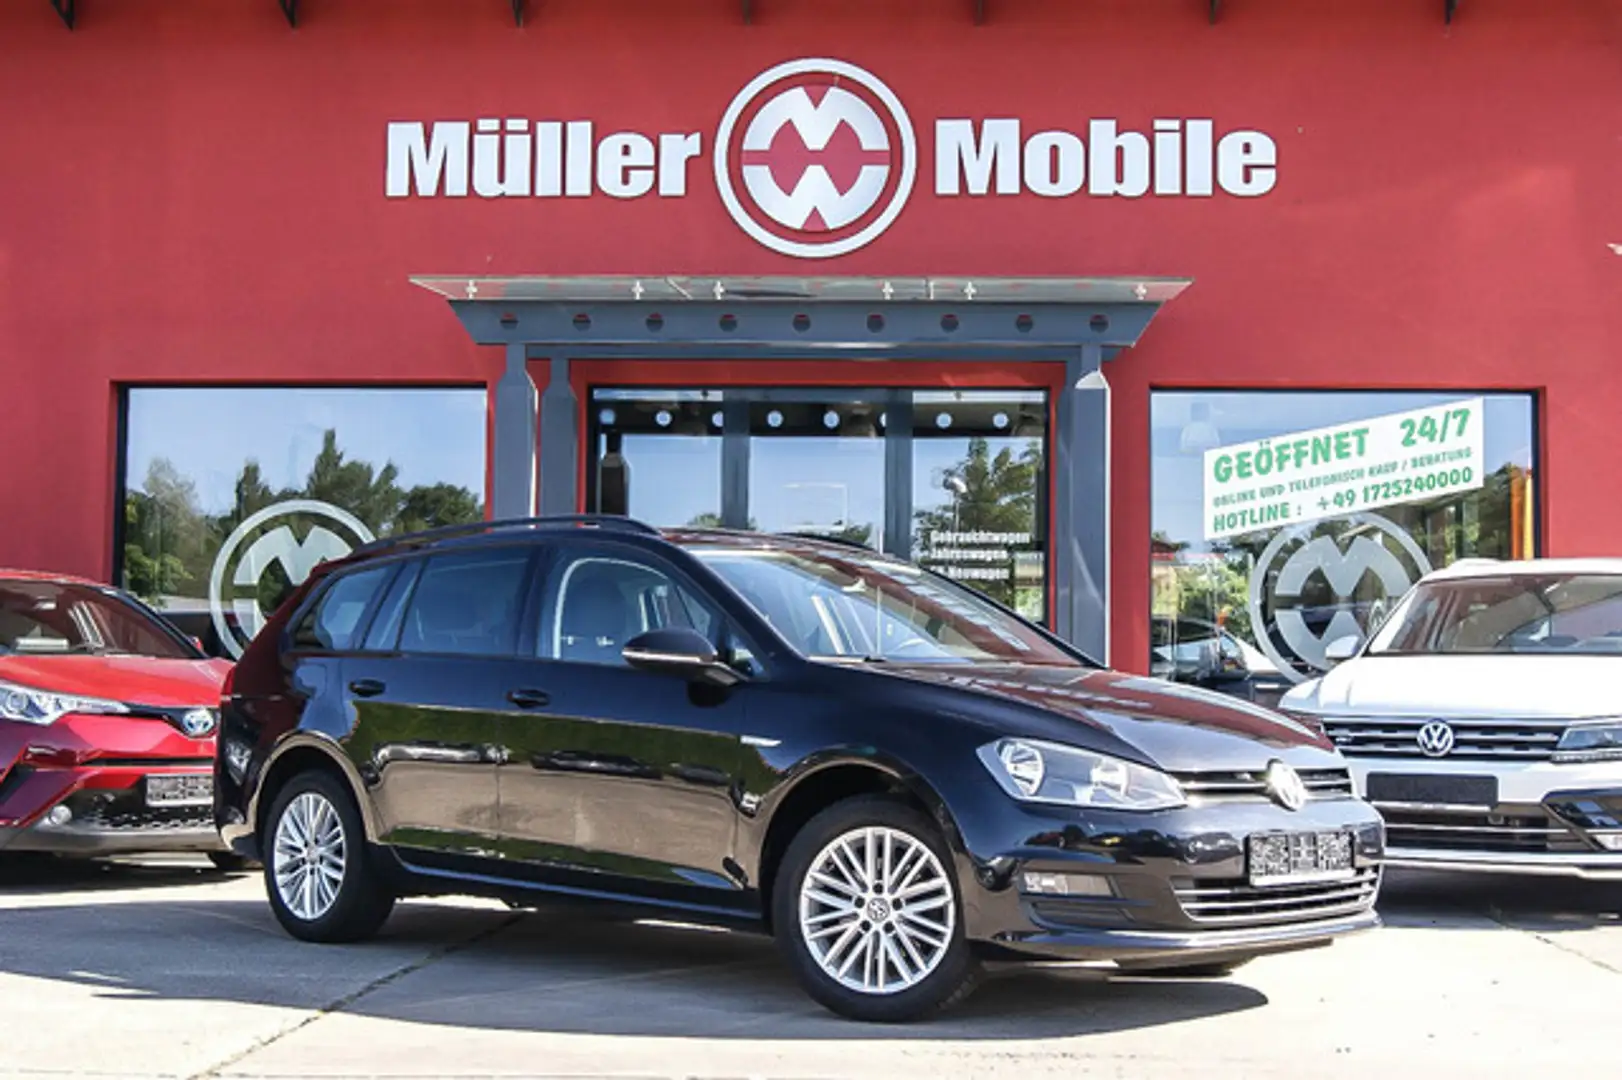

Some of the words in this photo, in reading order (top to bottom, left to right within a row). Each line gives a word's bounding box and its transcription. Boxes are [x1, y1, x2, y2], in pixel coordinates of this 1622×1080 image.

[386, 118, 700, 198] Müller
[935, 118, 1278, 197] Mobile
[1213, 428, 1369, 484] GEÖFFNET
[1400, 408, 1471, 448] 24/7
[1213, 488, 1256, 508] ONLINE
[1259, 483, 1285, 499] UND
[1289, 468, 1365, 493] TELEFONISCH
[1368, 460, 1398, 478] KAUF
[1410, 446, 1472, 470] BERATUNG
[1213, 502, 1290, 533] HOTLINE
[1363, 466, 1473, 503] 1725240000
